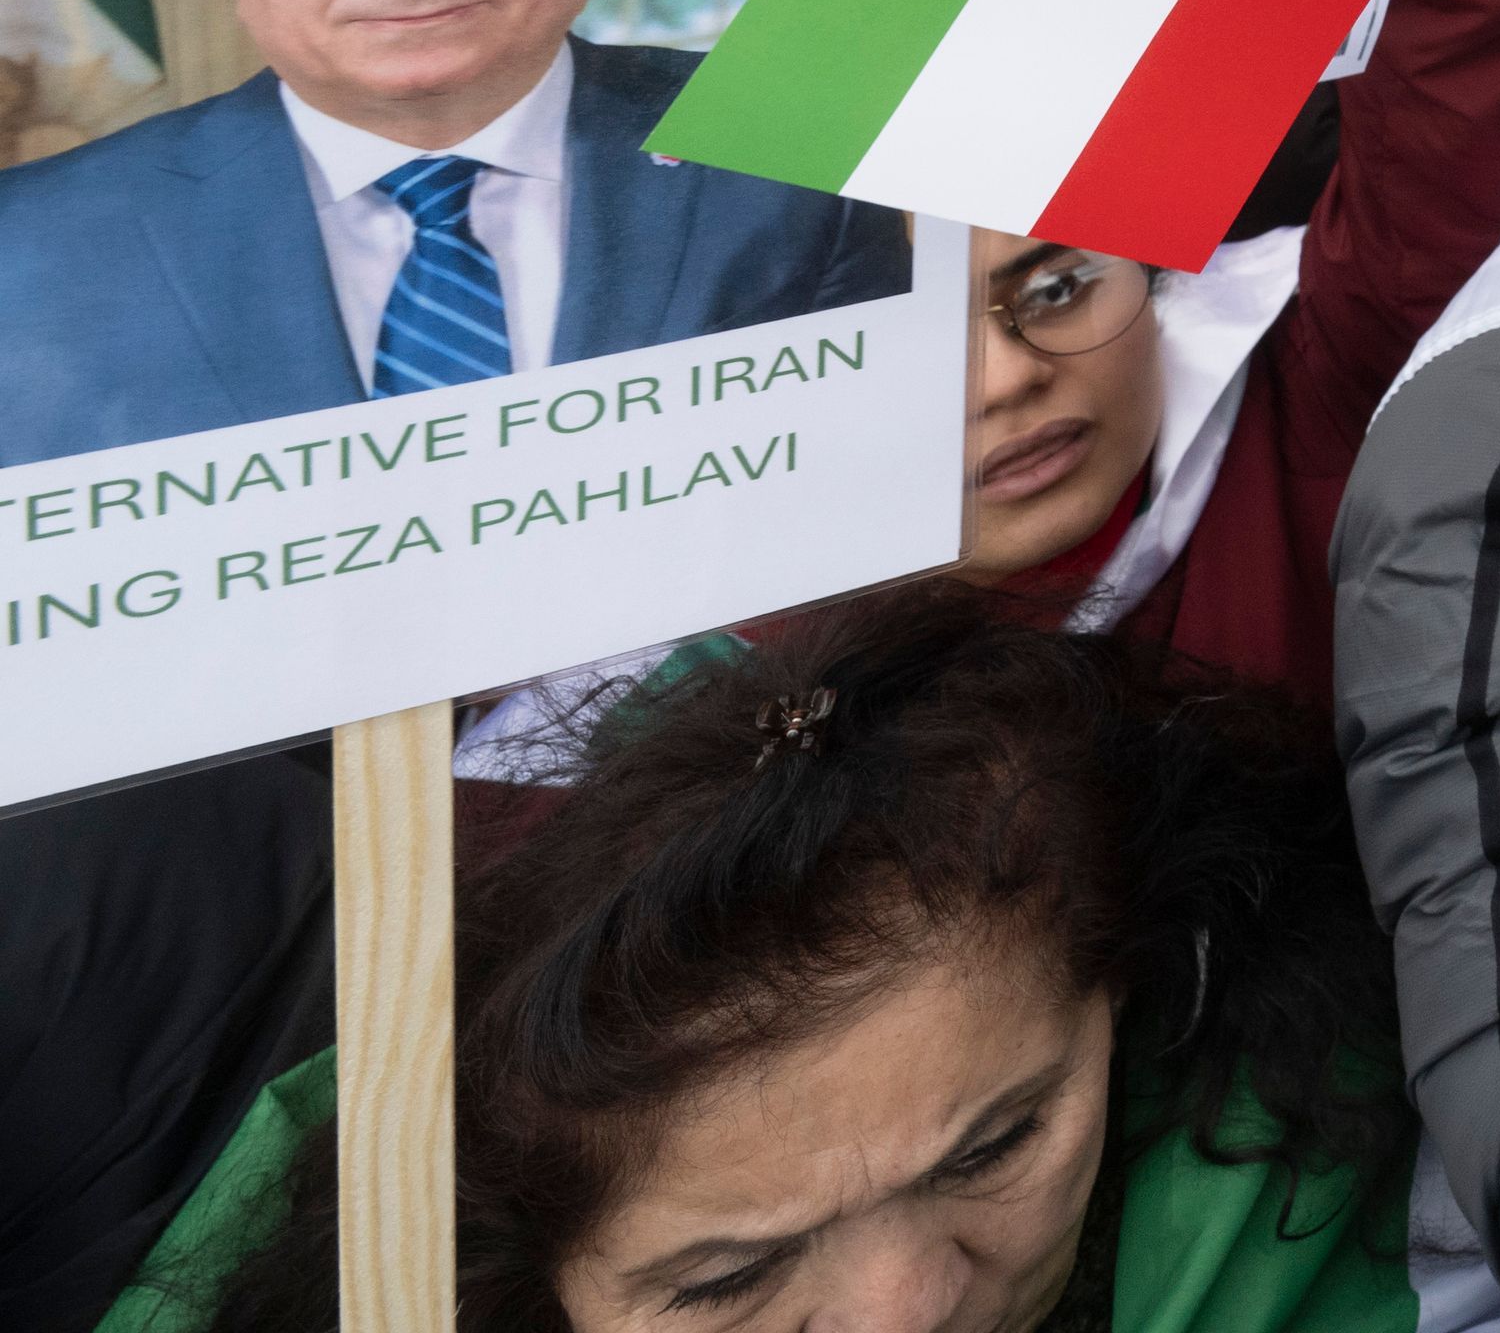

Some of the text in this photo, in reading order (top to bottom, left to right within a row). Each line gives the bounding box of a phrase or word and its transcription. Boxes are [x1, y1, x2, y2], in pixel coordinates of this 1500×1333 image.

[0, 329, 867, 541] ERNATIVE FOR IRAN
[8, 430, 800, 647] ING REZA PAHLAVI
